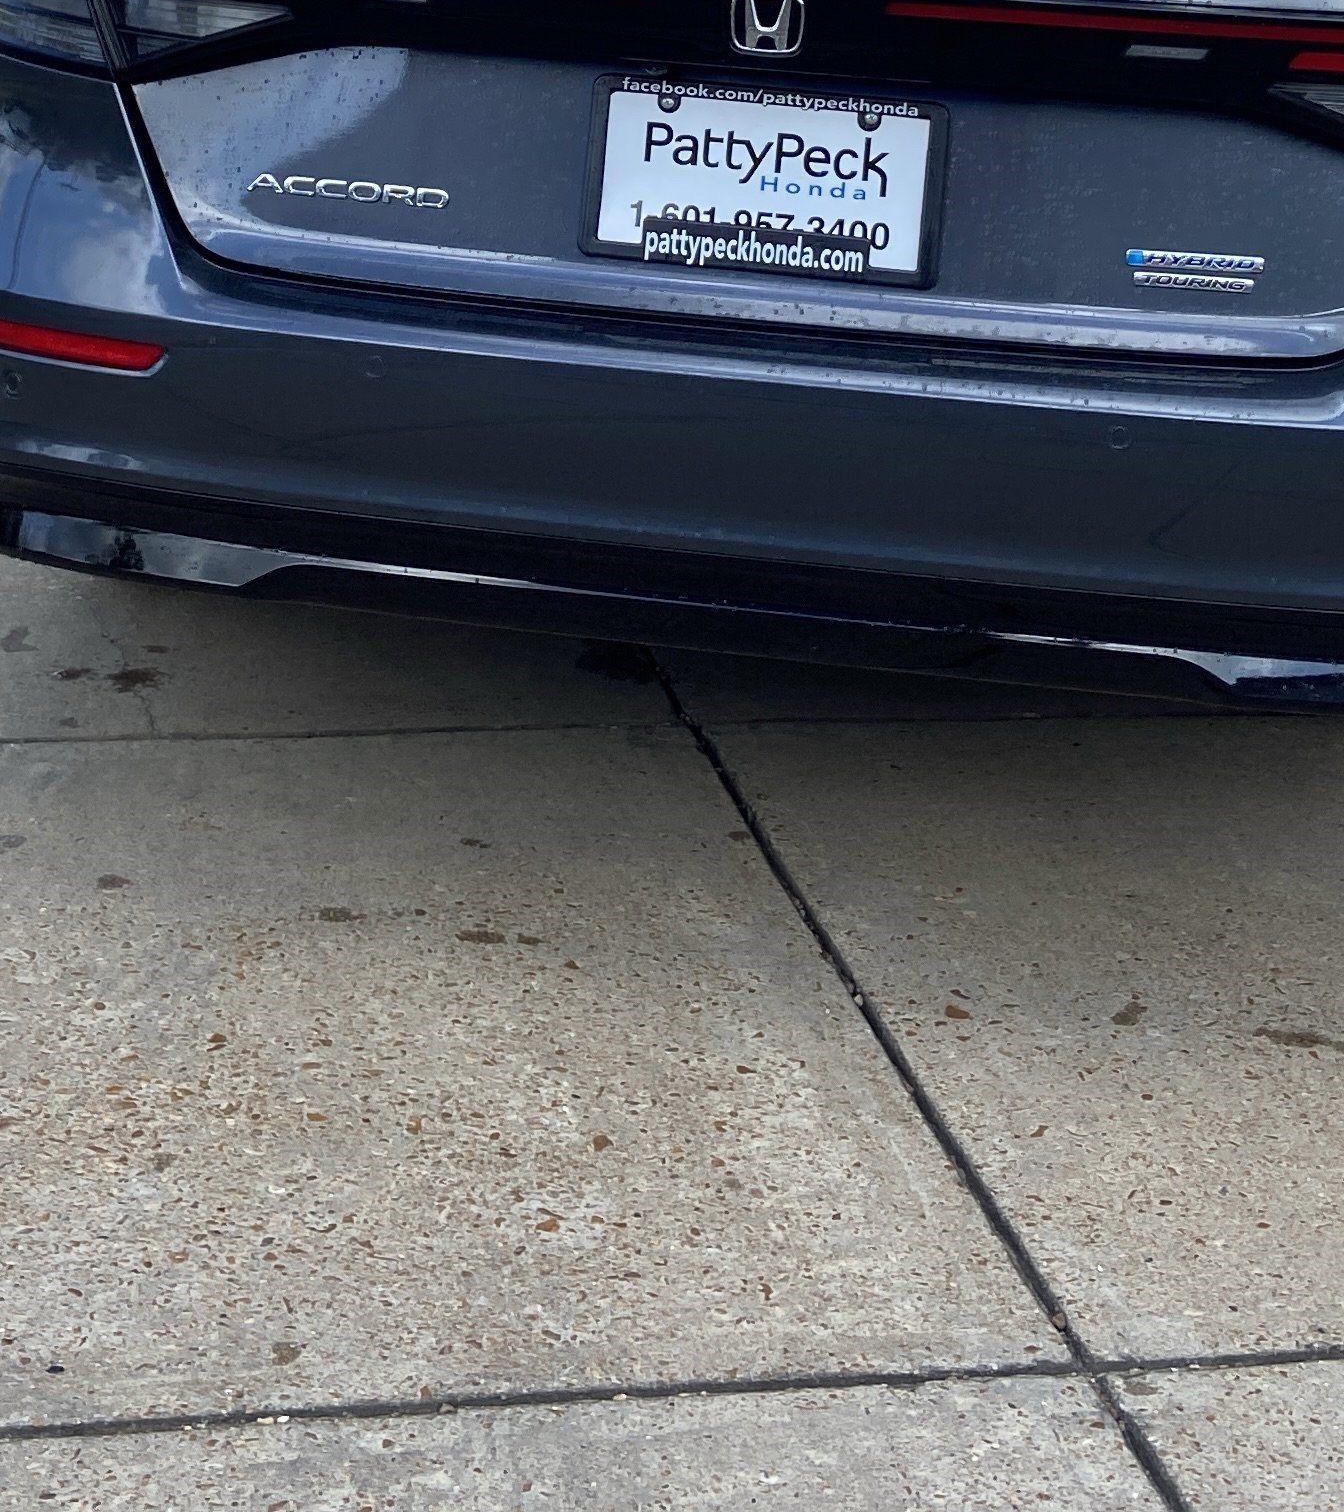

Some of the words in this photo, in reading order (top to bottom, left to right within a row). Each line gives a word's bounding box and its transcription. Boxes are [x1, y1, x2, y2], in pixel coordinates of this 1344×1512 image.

[622, 77, 919, 117] facebook.com/pattypeckhonda
[643, 120, 890, 198] PattyPeck
[246, 173, 450, 209] ACCORD
[760, 175, 867, 201] Honda
[643, 228, 864, 273] pattypeckhonda.com
[1147, 252, 1256, 271] HYBRID
[1142, 274, 1246, 291] TOURING
